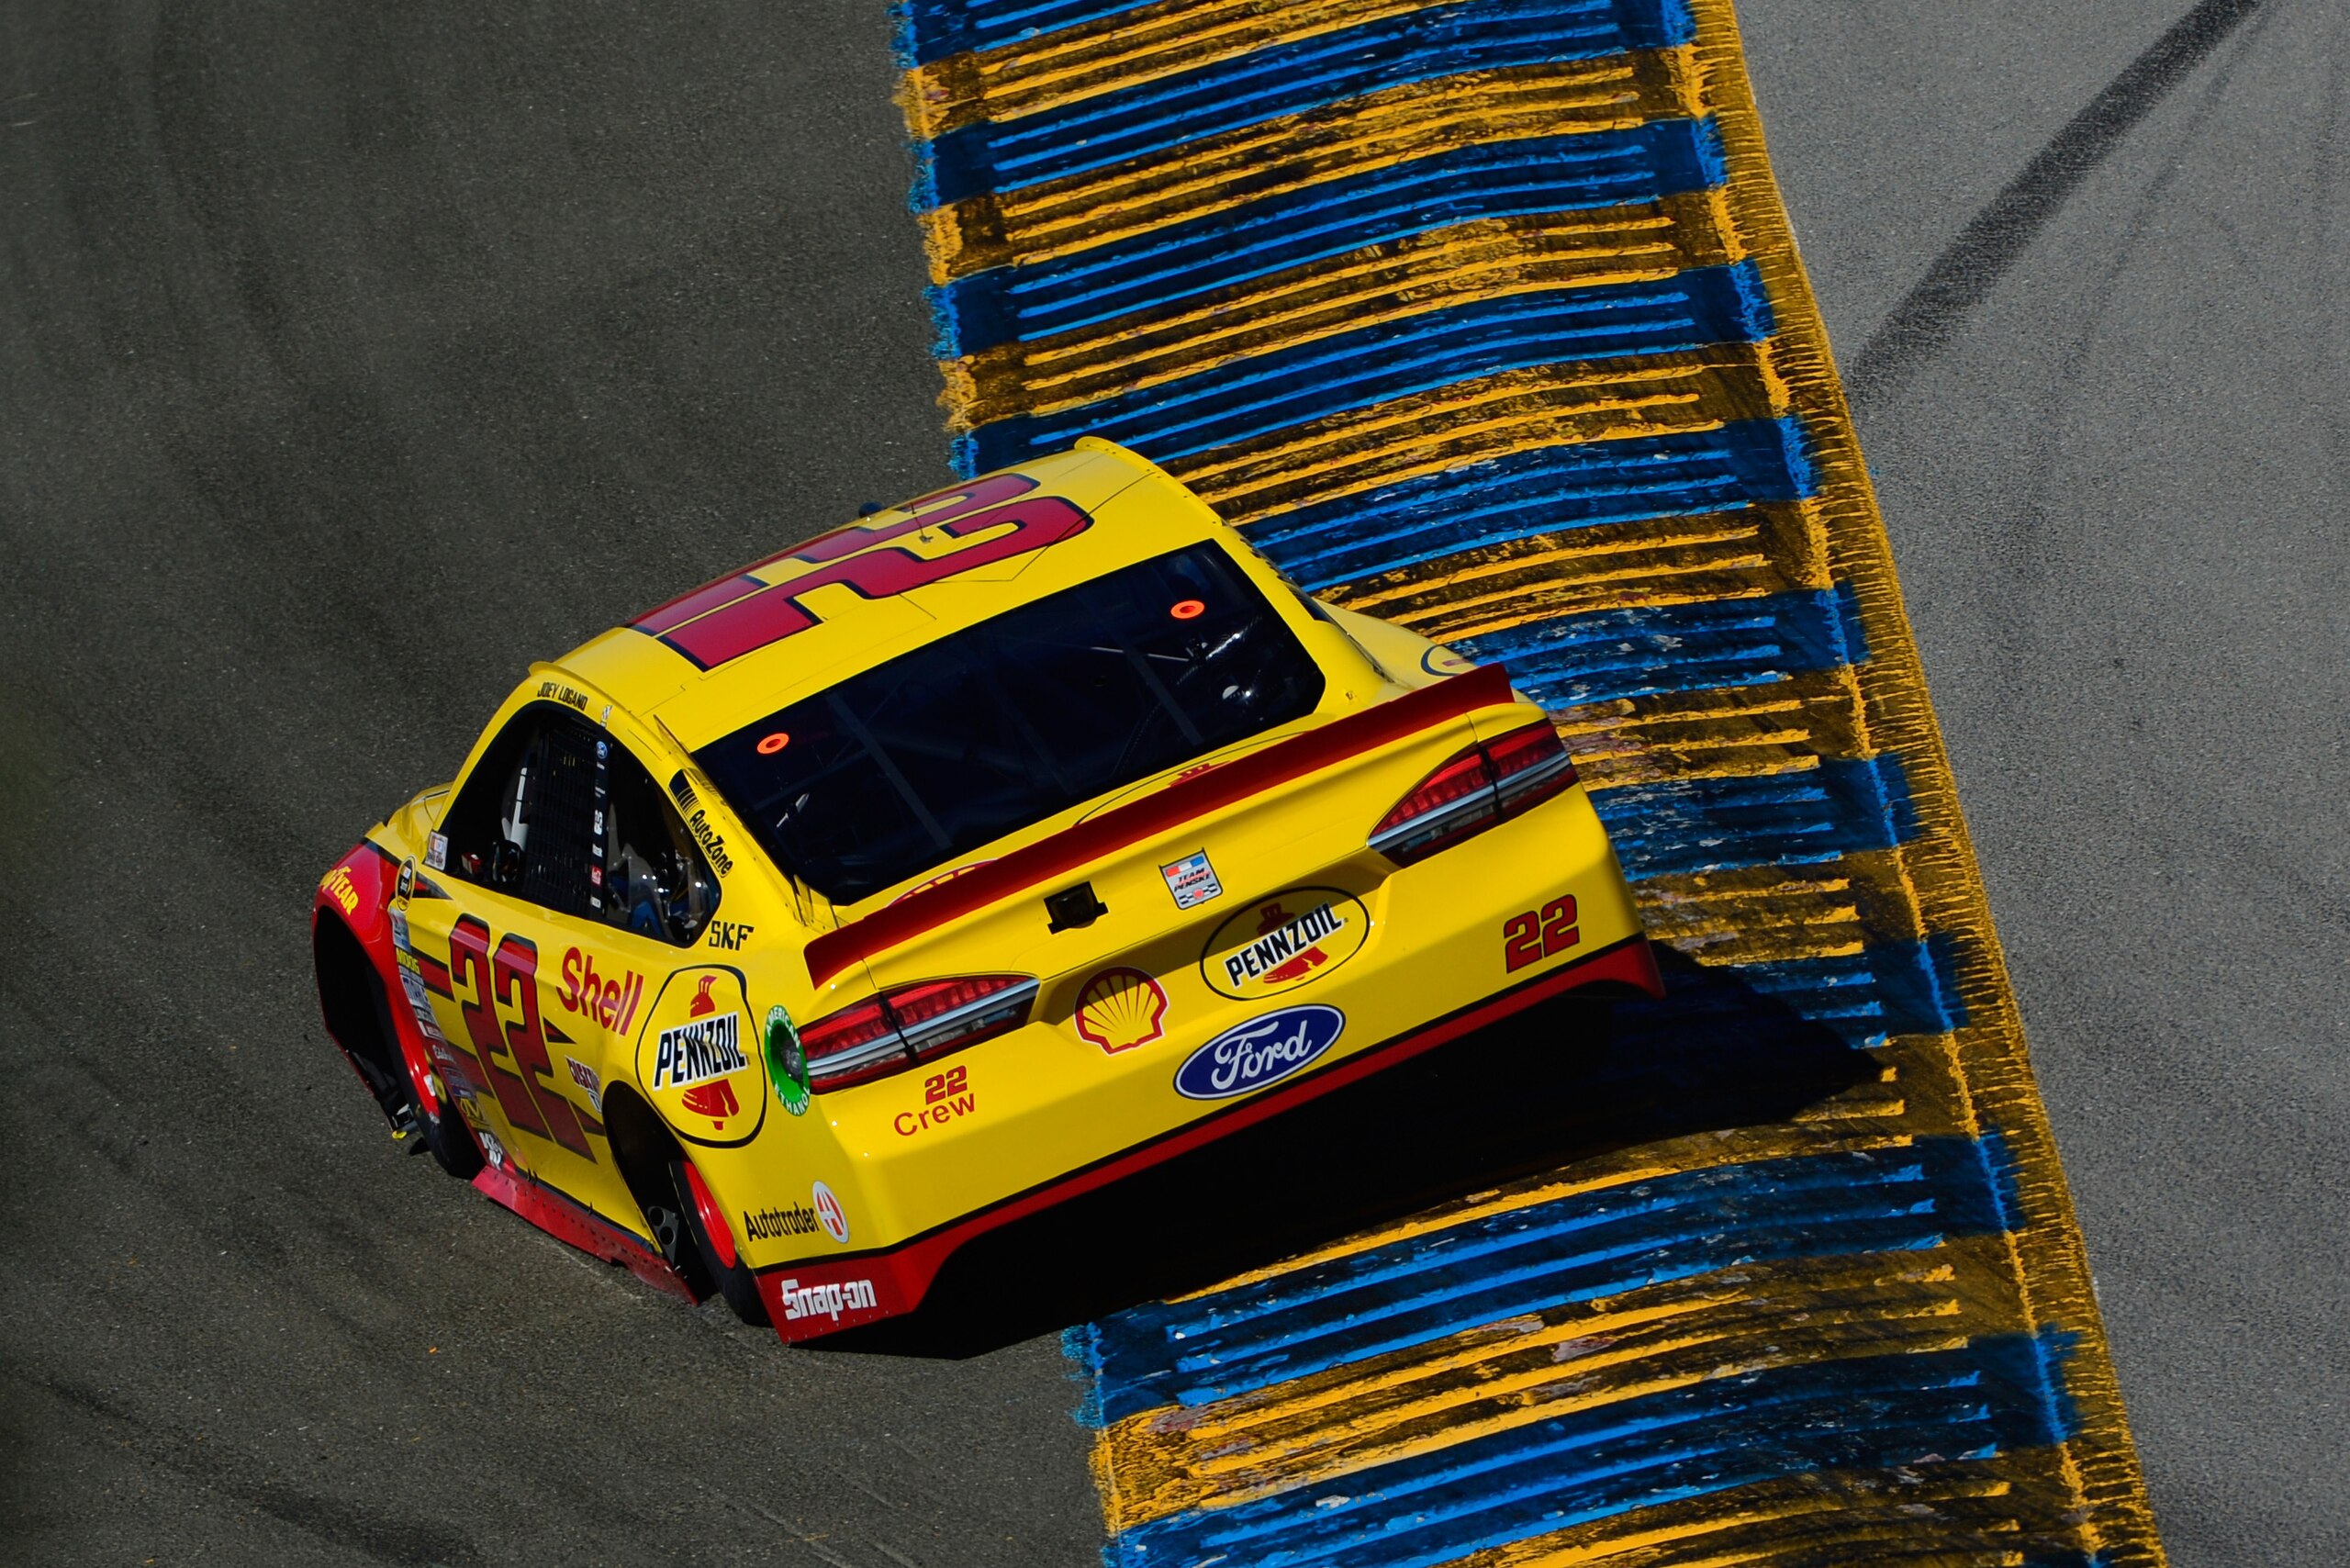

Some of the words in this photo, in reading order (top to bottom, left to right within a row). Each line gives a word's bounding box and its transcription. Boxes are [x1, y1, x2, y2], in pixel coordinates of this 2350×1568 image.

[632, 473, 1095, 673] 22
[537, 681, 559, 700] JOEY
[557, 686, 588, 711] LOGANO
[689, 809, 733, 876] AutoZone
[1174, 873, 1212, 892] PENSKE
[1178, 868, 1205, 882] TEAM
[709, 920, 755, 951] SKF
[1225, 902, 1342, 989] PENNZOIL
[1503, 893, 1581, 975] 22
[556, 946, 644, 1036] Shell
[449, 913, 599, 1166] 22
[767, 1006, 800, 1048] AMERICAN
[654, 1012, 749, 1091] PENNZOIL
[1211, 1020, 1313, 1091] Ford
[774, 1081, 810, 1116] ETHANOL
[924, 1065, 968, 1105] 22
[893, 1092, 976, 1137] Crew
[743, 1202, 820, 1242] Autotrader
[781, 1279, 878, 1321] Snap-on
